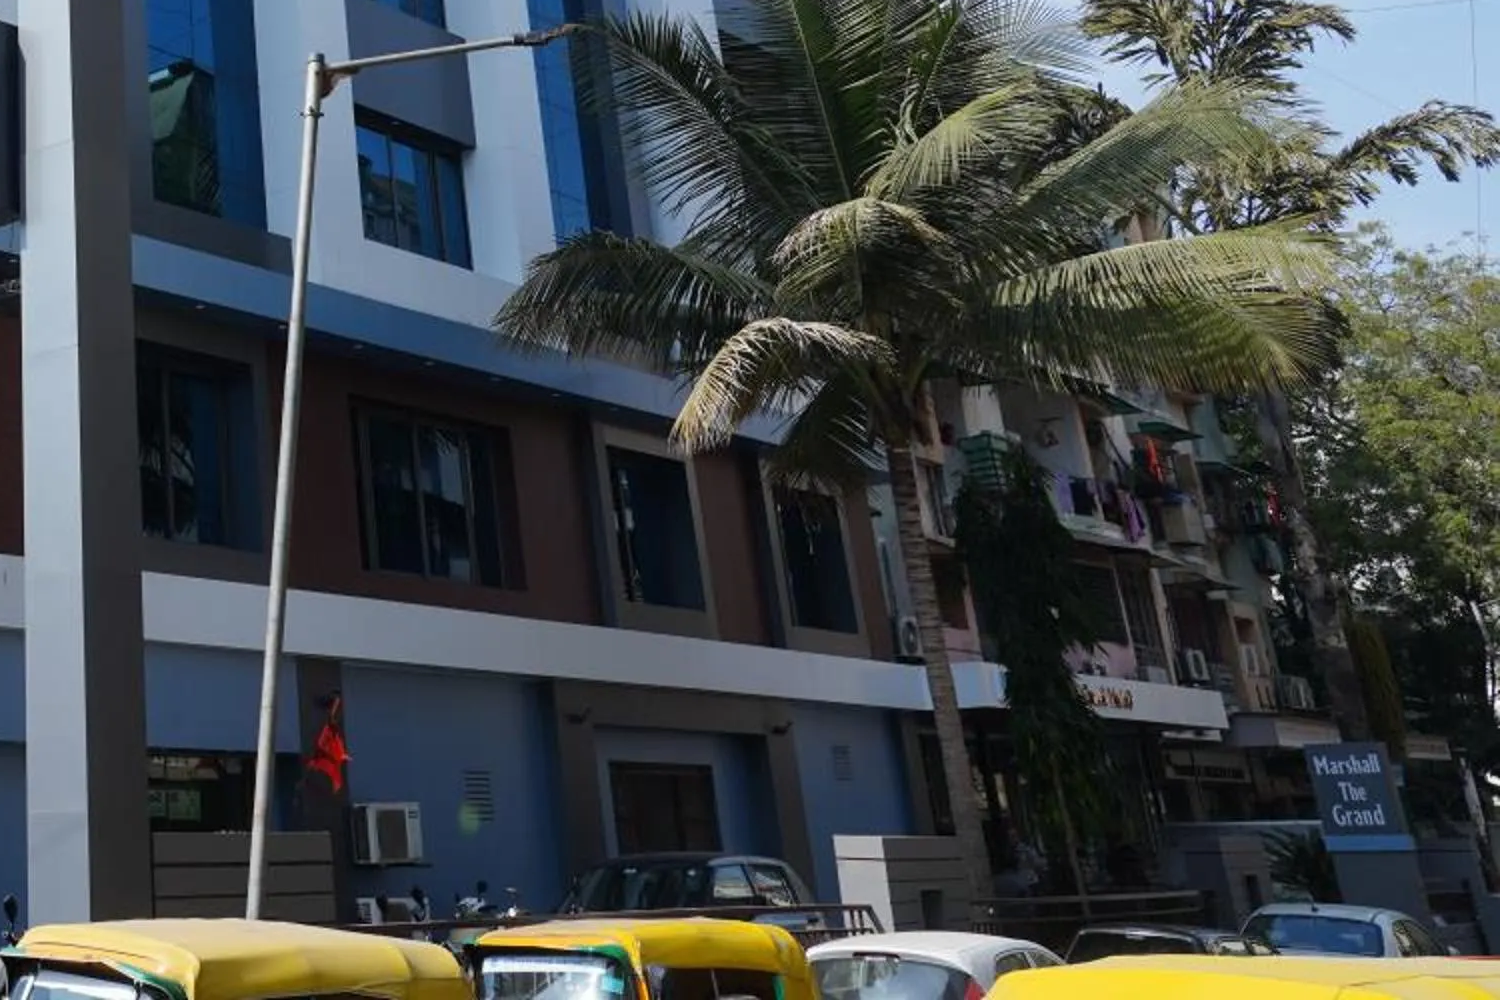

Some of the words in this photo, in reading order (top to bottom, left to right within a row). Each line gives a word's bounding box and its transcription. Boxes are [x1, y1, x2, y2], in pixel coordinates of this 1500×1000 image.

[1312, 753, 1381, 775] Marshall
[1338, 781, 1368, 802] The
[1332, 804, 1386, 827] Grand
